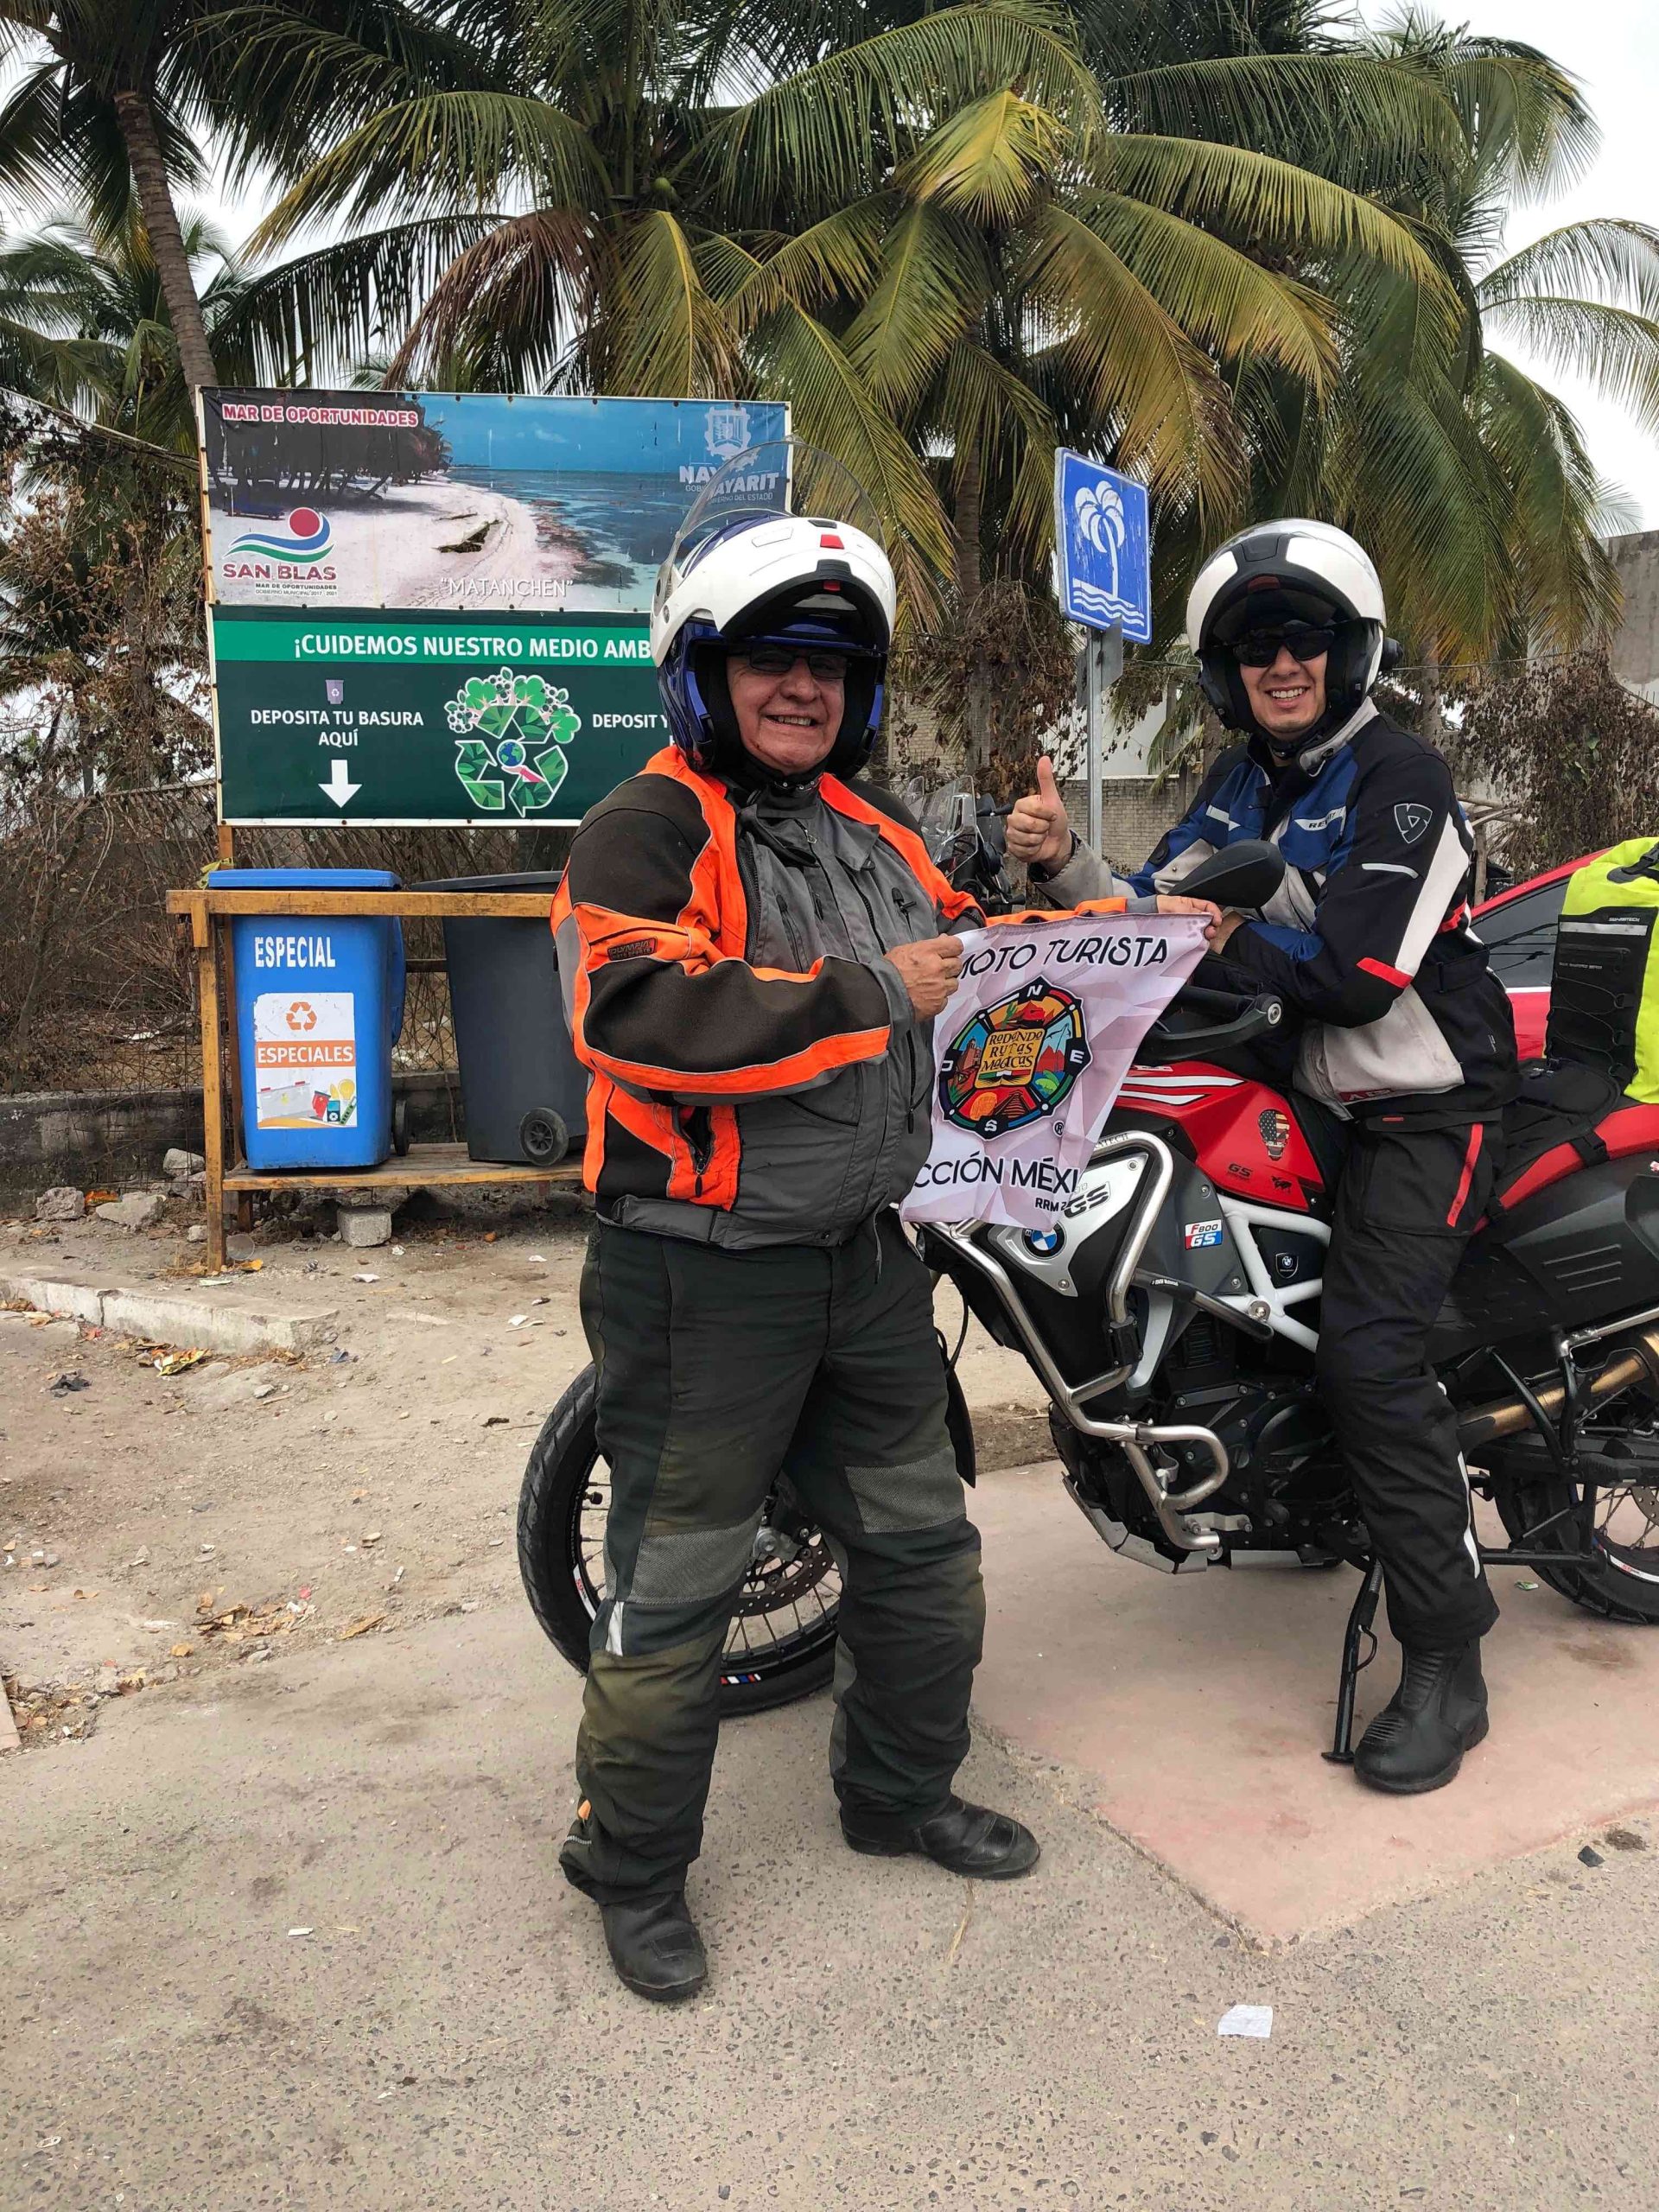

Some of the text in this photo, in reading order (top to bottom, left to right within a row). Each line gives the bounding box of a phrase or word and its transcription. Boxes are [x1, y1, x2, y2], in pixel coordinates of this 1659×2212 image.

[222, 404, 418, 428] MAR DE OPORTUNIDADES
[747, 492, 773, 501] ESTADO
[223, 563, 337, 581] SAN BLAS
[295, 633, 652, 659] ¡CUIDEMOS NUESTRO MEDIO AMB
[251, 709, 424, 726] DEPOSITA TU BASURA
[592, 714, 658, 728] DEPOSIT
[318, 728, 359, 747] AQUÍ
[254, 936, 336, 968] ESPECIAL
[1043, 936, 1168, 967] TURISTA
[1027, 984, 1043, 997] N
[257, 1046, 353, 1064] ESPECIALES
[1070, 1049, 1085, 1064] E
[984, 1119, 997, 1132] S
[914, 1150, 1079, 1194] CCIÓN MÉXI
[1228, 1162, 1253, 1177] GS
[1035, 1197, 1059, 1212] RRM
[1064, 1183, 1110, 1218] GS
[1191, 1224, 1219, 1235] F800
[1190, 1232, 1217, 1248] GS
